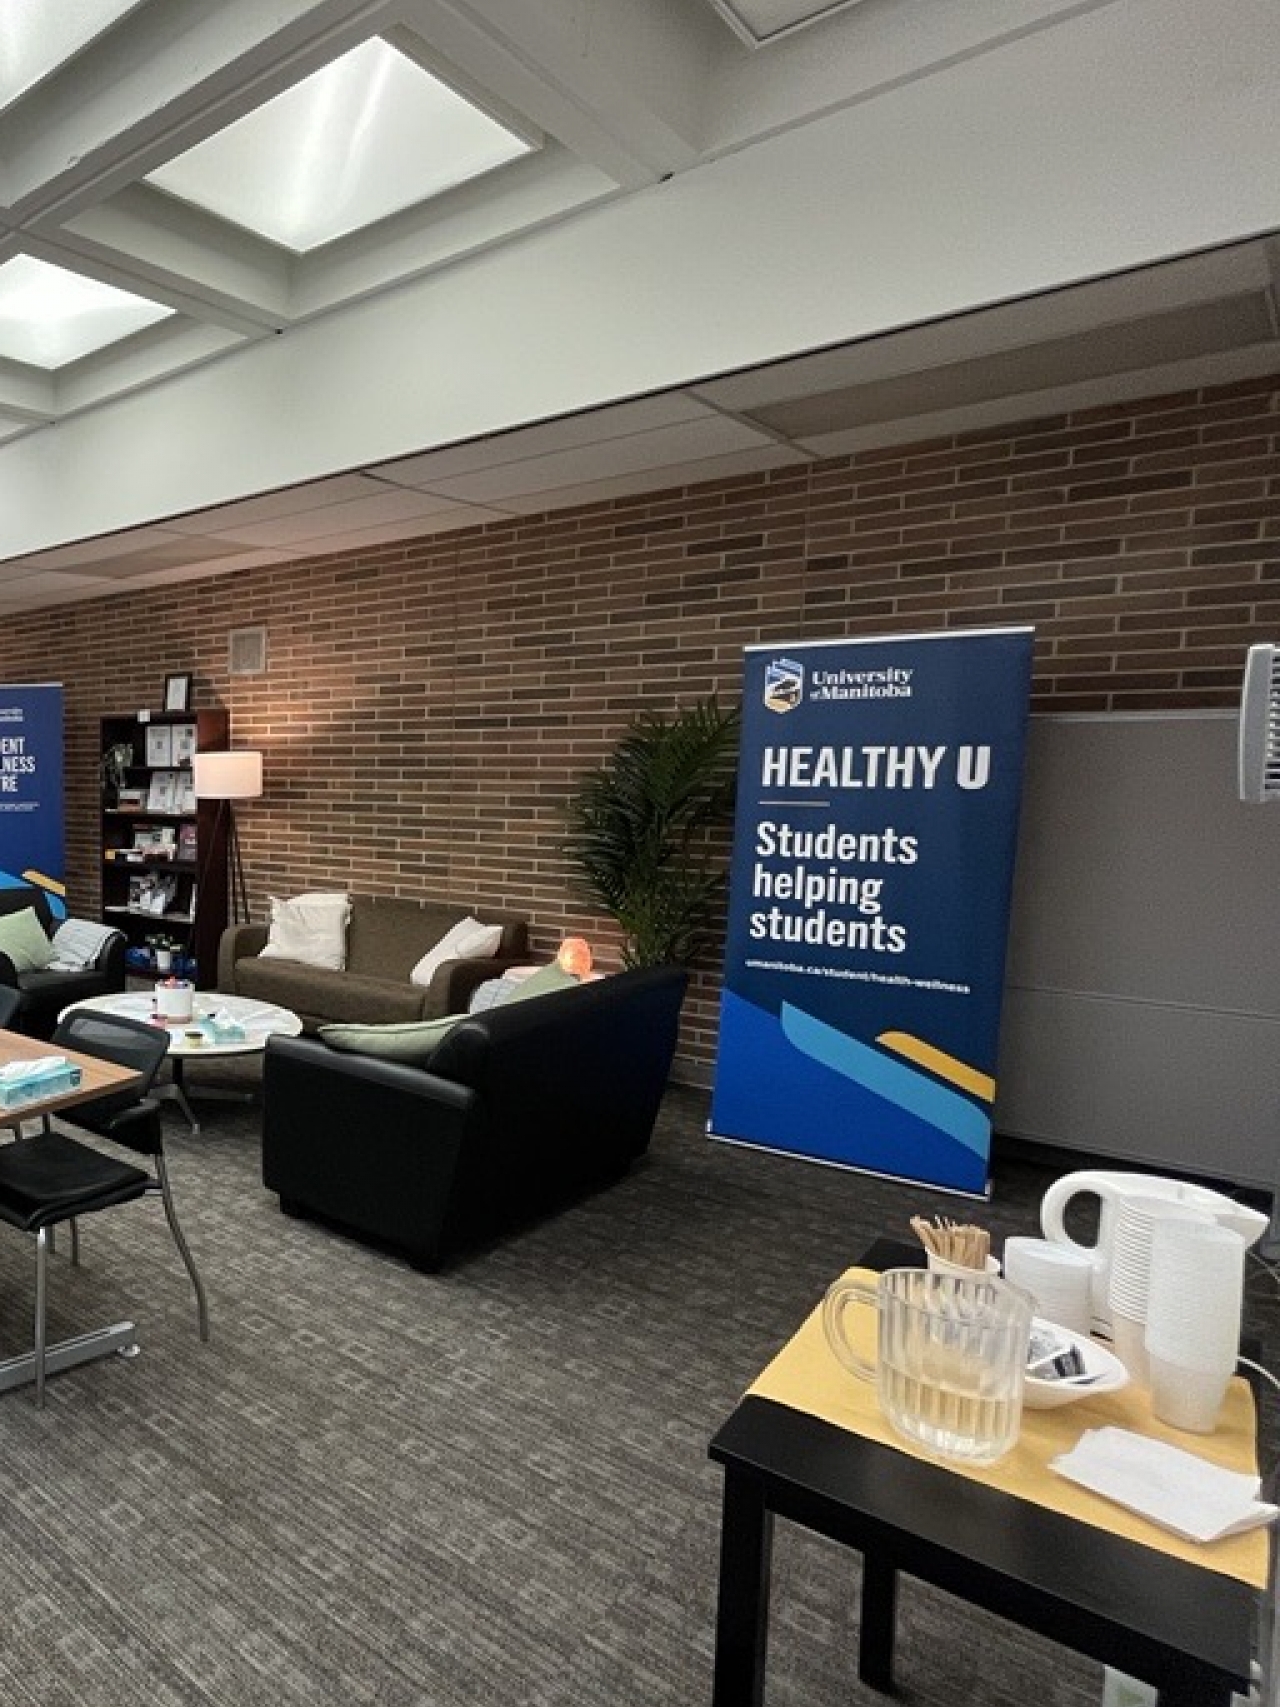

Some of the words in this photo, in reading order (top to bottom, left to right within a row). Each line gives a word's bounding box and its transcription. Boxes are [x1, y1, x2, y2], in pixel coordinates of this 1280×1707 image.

[812, 667, 913, 685] University
[821, 684, 912, 700] Manitoba
[762, 746, 946, 789] HEALTHY
[956, 745, 991, 789] U
[755, 821, 919, 864] Students
[753, 863, 884, 915] helping
[749, 906, 907, 953] students
